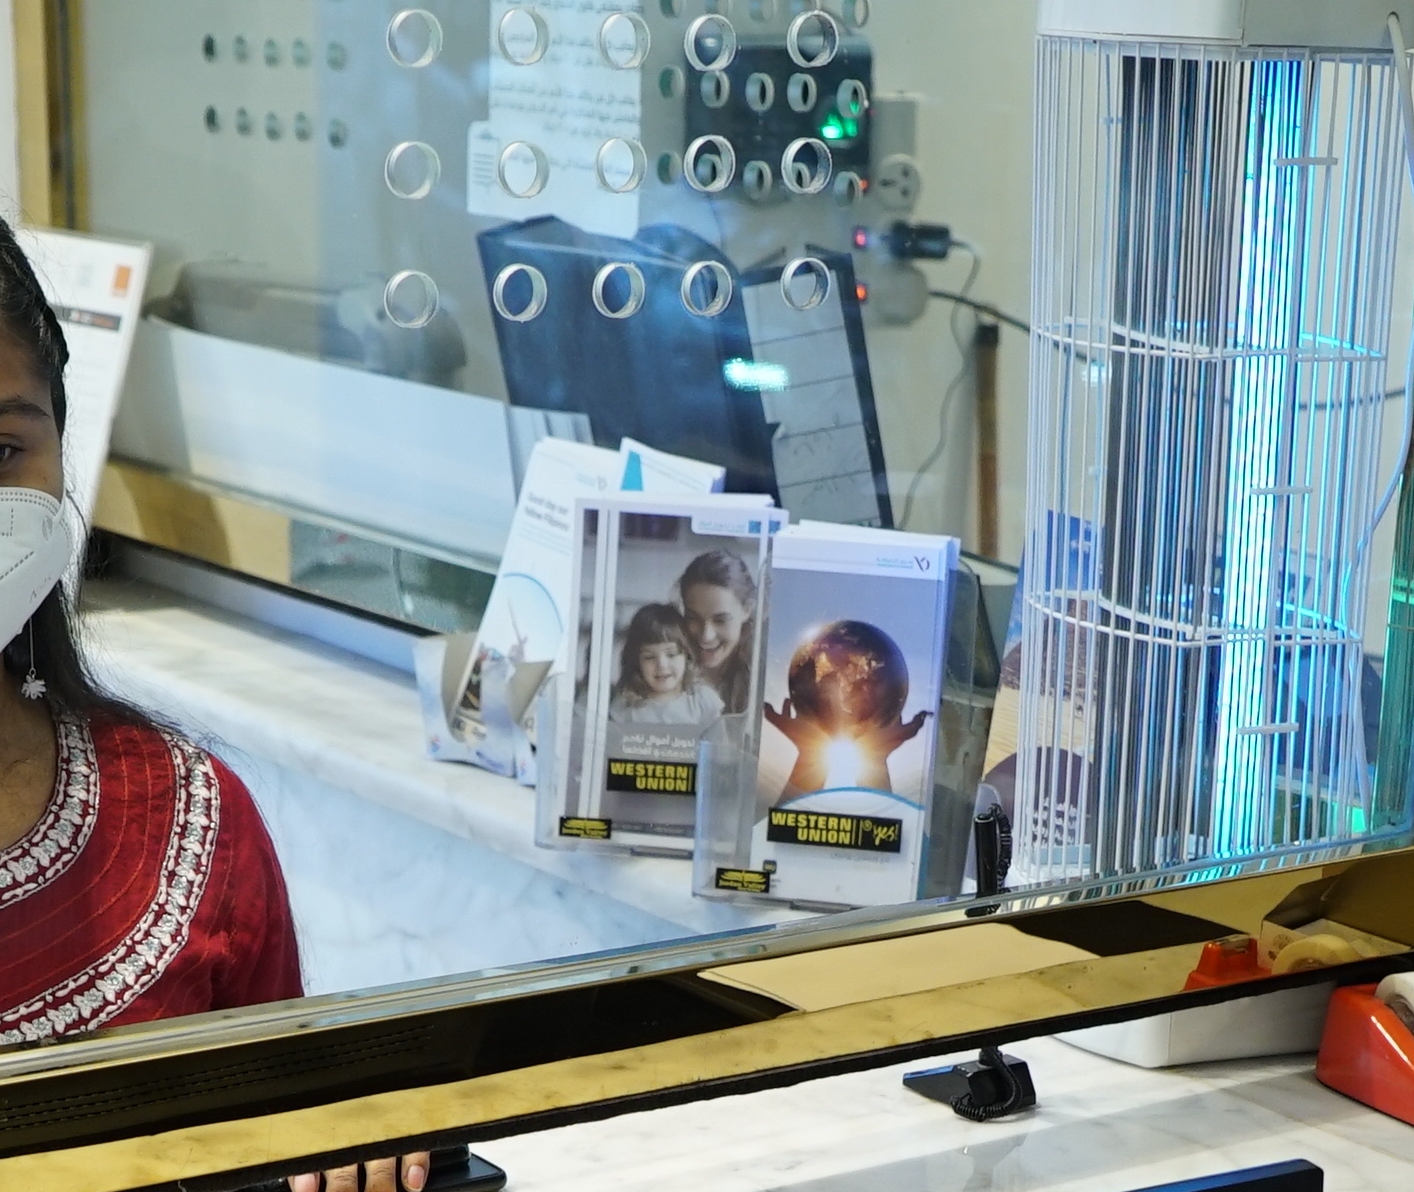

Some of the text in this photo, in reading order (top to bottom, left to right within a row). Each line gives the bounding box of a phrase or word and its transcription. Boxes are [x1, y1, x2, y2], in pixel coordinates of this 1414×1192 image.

[610, 762, 688, 778] WESTERN
[635, 777, 687, 792] UNION
[771, 811, 900, 846] WESTERN yes!
[797, 828, 851, 845] UNION
